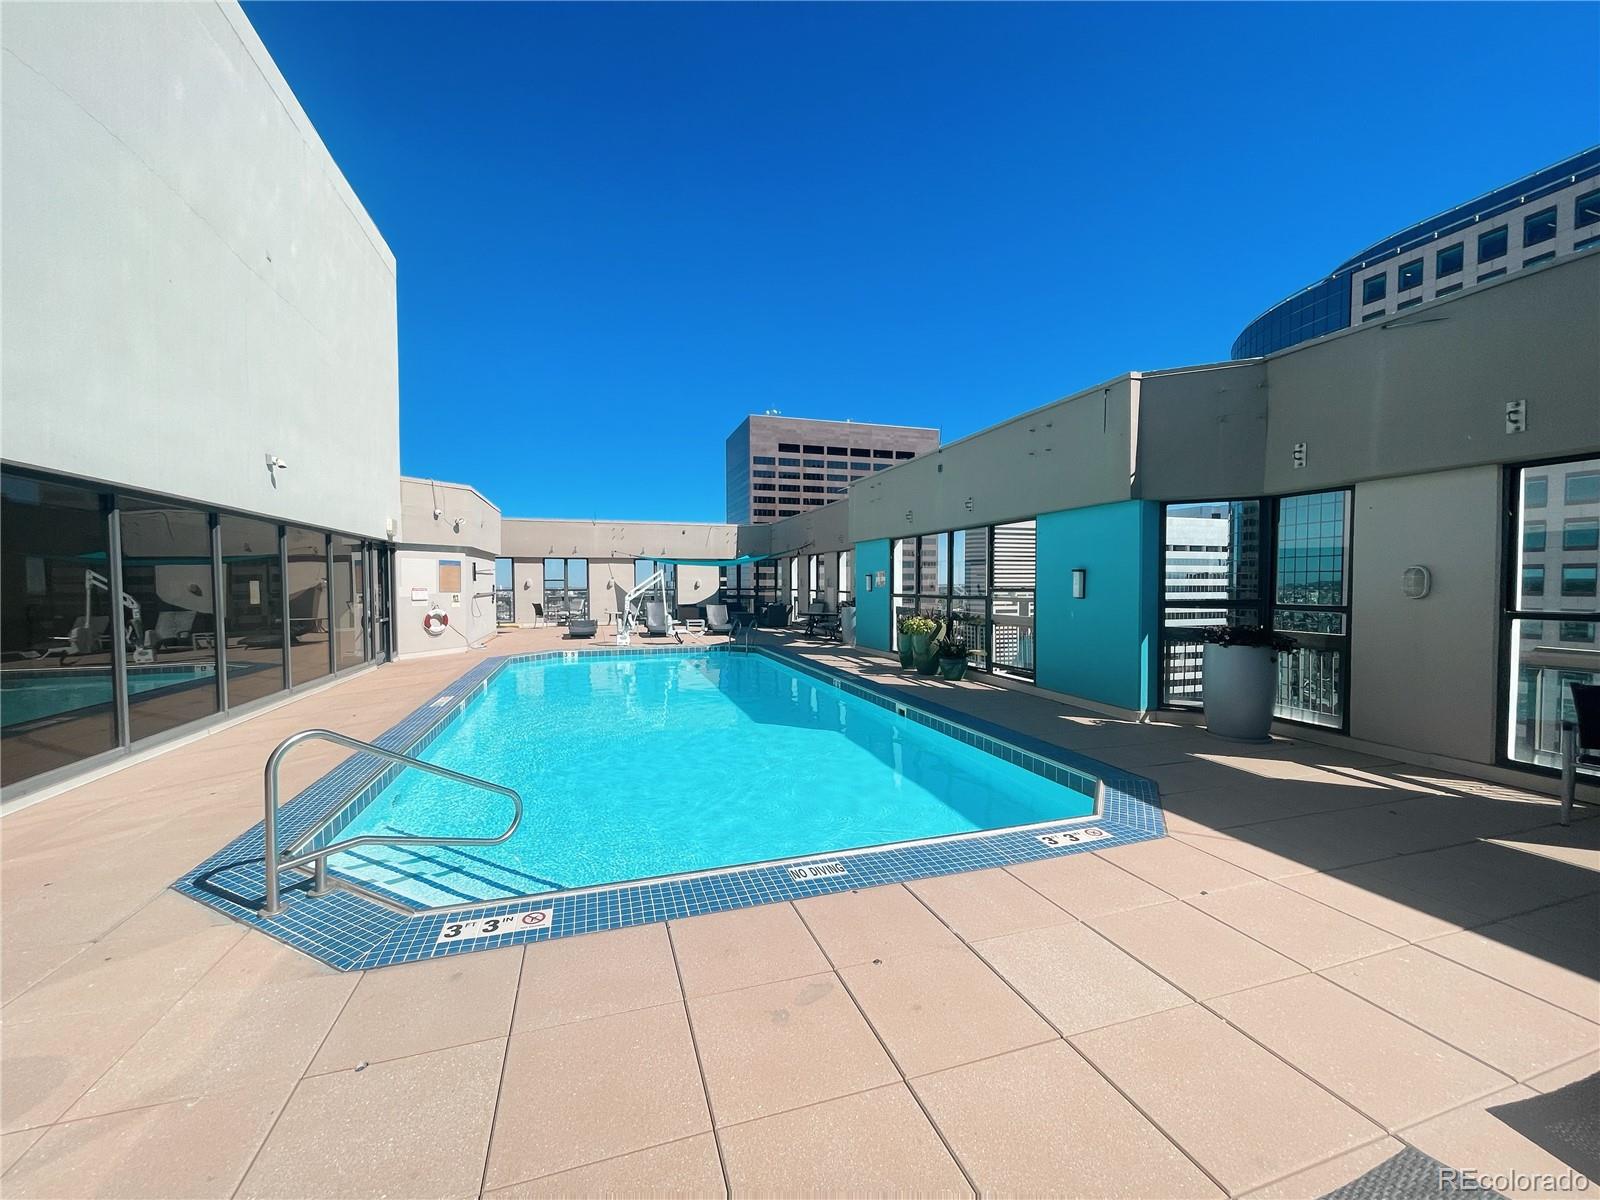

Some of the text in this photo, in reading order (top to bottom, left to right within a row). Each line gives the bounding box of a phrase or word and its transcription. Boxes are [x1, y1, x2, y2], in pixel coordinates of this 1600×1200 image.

[1042, 836, 1058, 844] 3
[790, 863, 845, 879] NO DIVING
[444, 924, 463, 938] 3
[482, 919, 500, 933] 3
